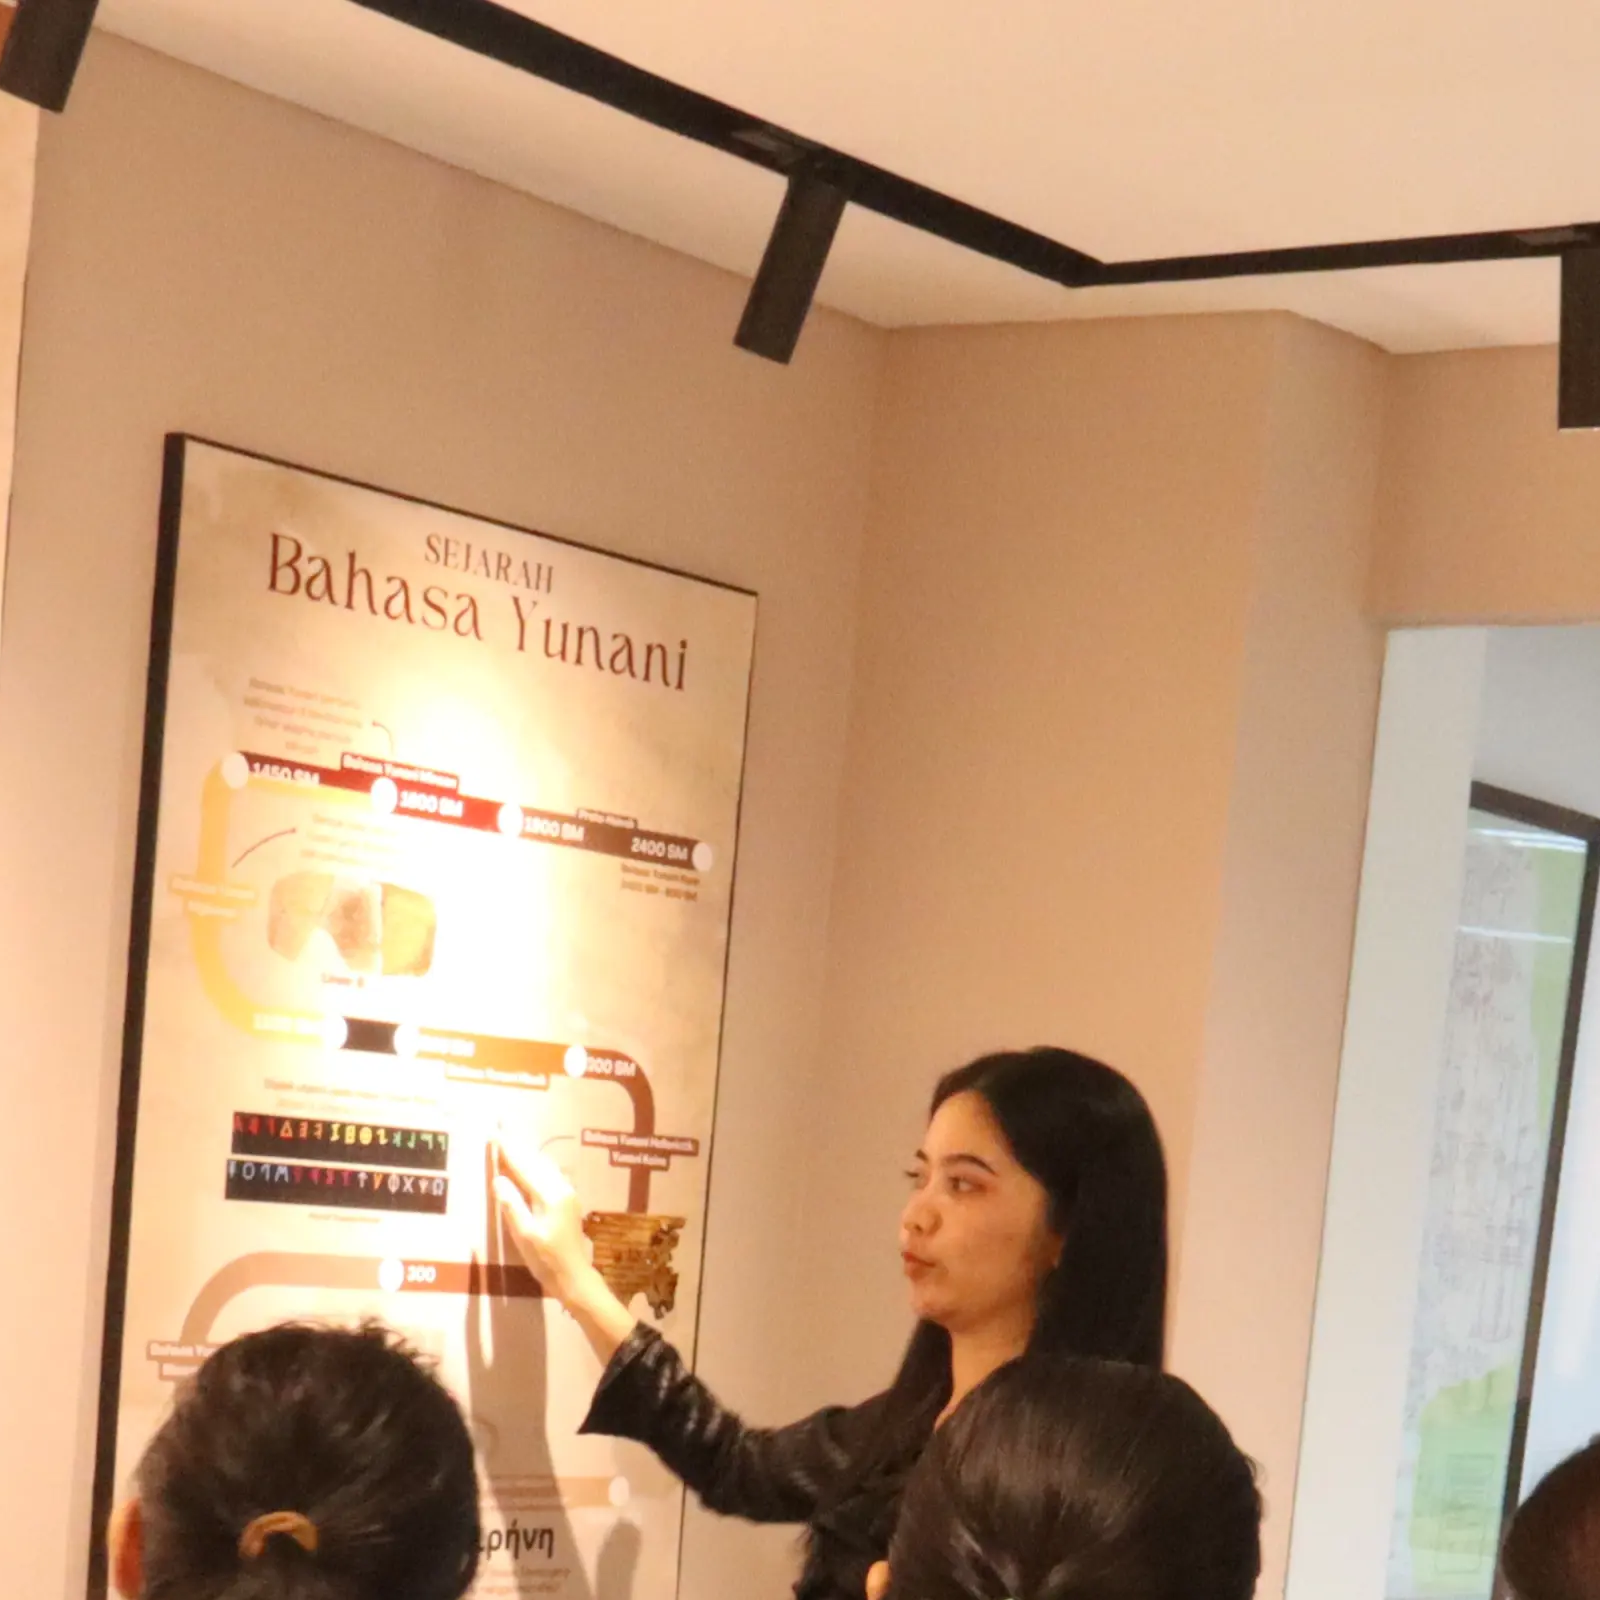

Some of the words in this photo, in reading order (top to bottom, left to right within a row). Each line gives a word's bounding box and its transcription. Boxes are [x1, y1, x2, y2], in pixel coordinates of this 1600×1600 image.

[423, 532, 556, 595] SEJARAH
[266, 530, 484, 643] Bahasa
[509, 594, 691, 692] Yunani
[631, 837, 667, 857] 2400
